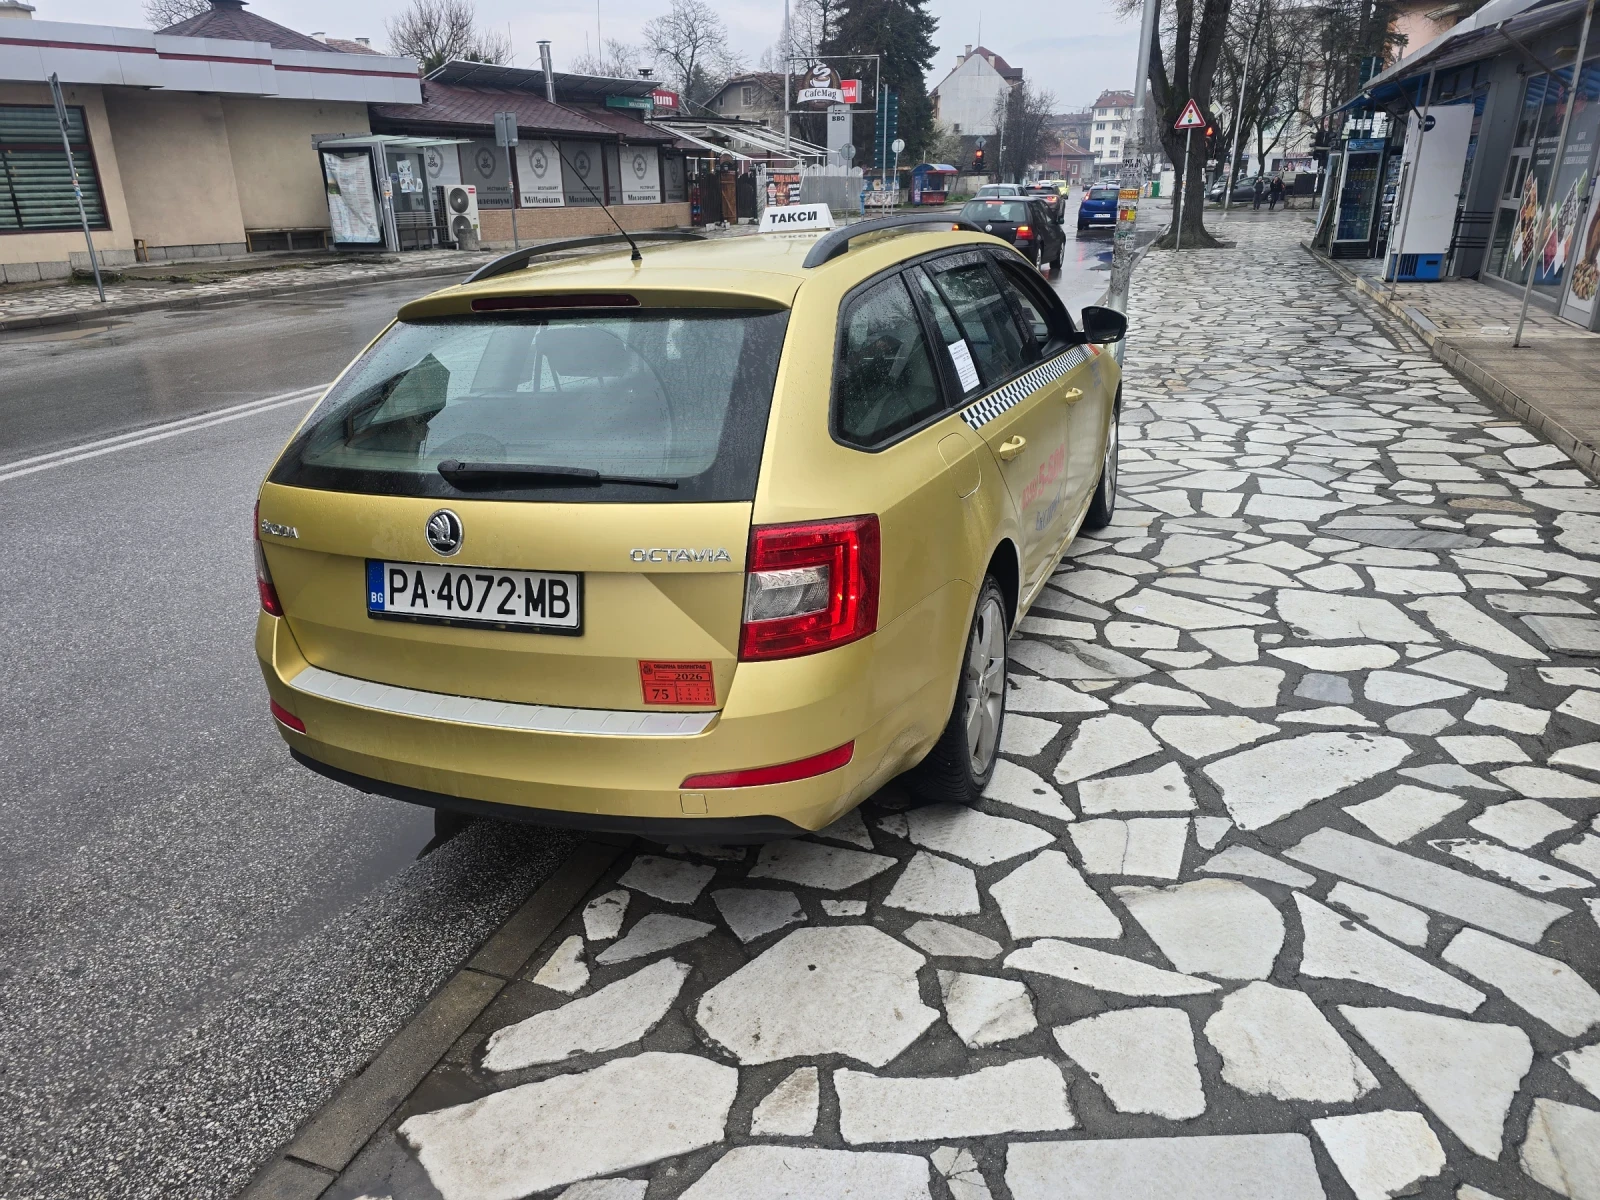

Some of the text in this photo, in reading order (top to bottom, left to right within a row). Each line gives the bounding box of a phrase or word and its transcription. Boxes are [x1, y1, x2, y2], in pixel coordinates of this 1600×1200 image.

[652, 92, 673, 106] ium
[804, 89, 837, 100] CafeMag
[478, 197, 510, 207] илениум
[524, 195, 561, 204] Millenium
[769, 210, 818, 224] ТАКСИ
[629, 547, 732, 563] OCTAVIA
[371, 591, 384, 604] BG
[652, 688, 669, 700] 75
